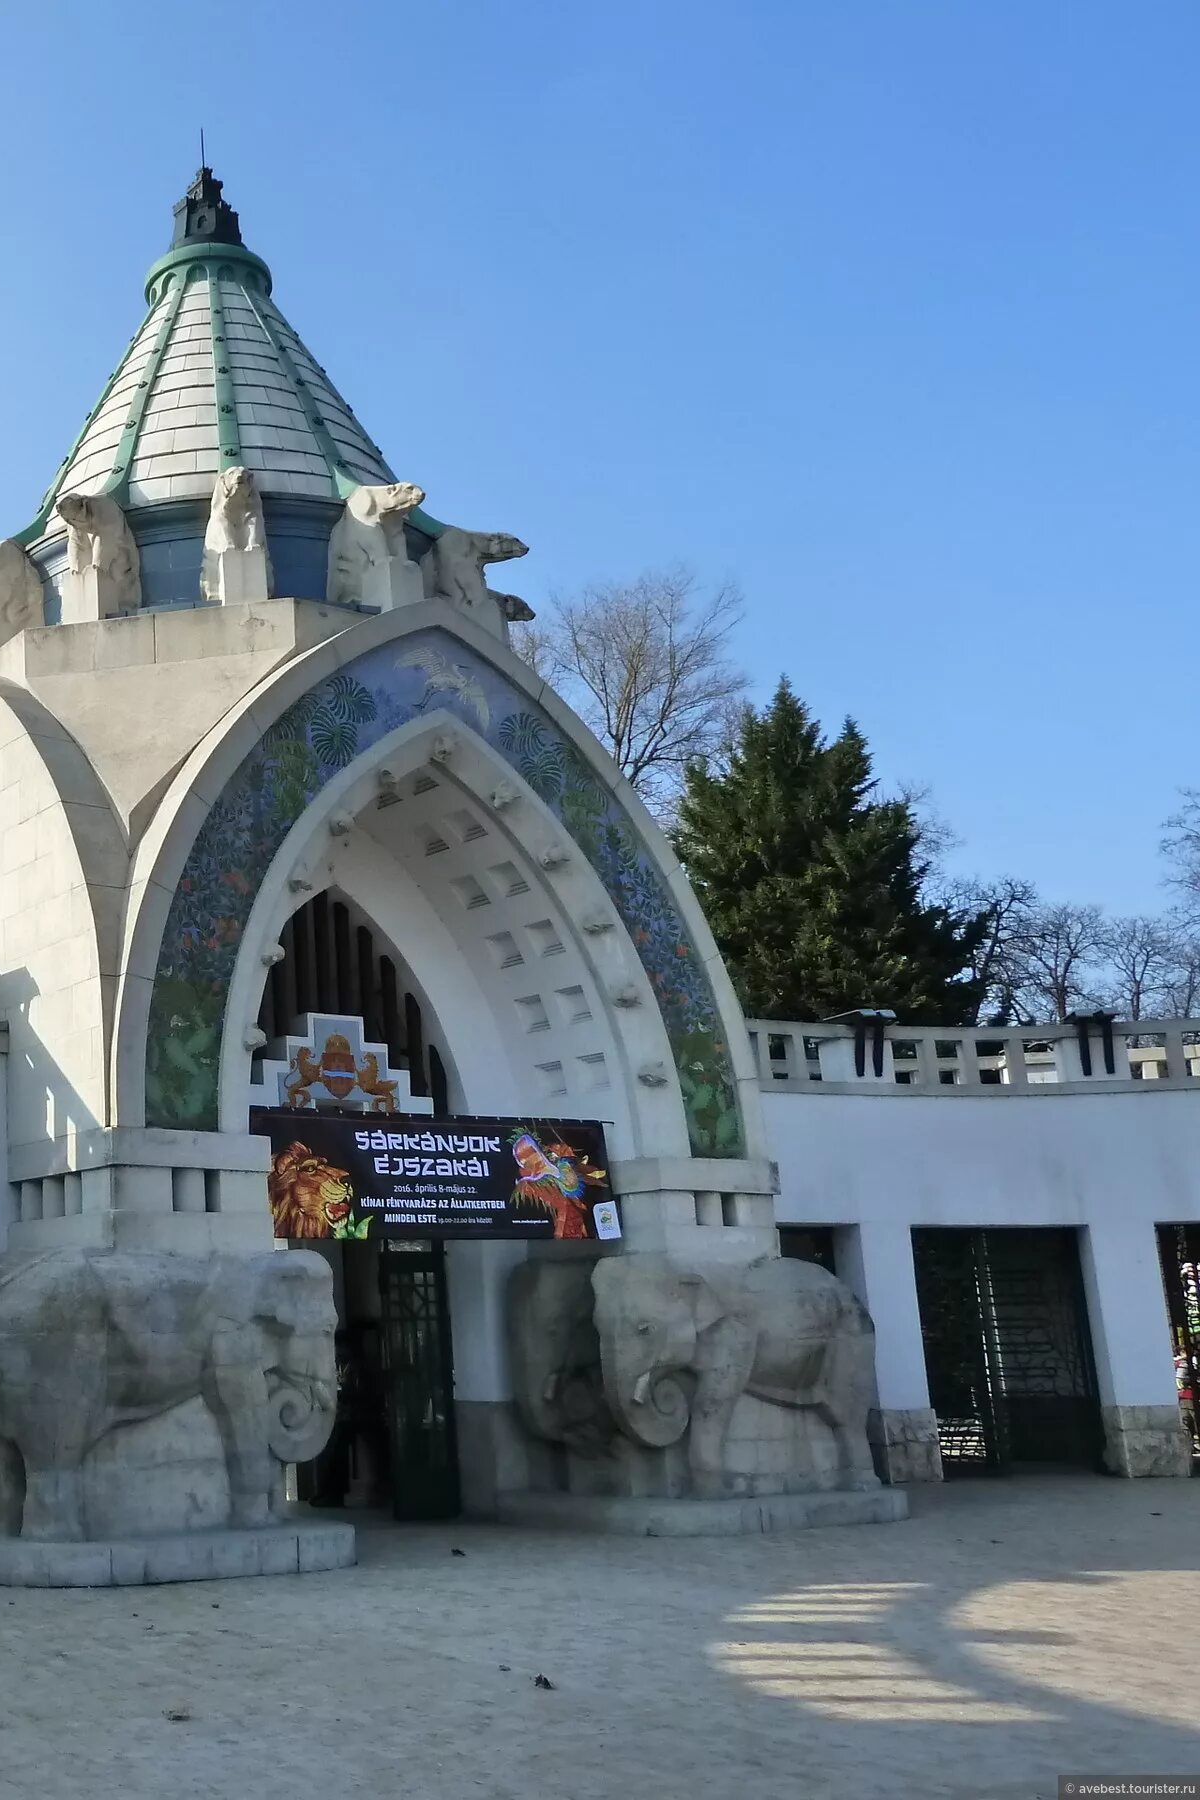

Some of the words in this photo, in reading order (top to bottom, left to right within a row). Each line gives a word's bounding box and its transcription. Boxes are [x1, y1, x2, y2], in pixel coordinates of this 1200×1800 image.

[355, 1129, 501, 1154] SÁRKÁNYOK
[373, 1153, 490, 1177] ÉJSZAKÁI
[393, 1185, 413, 1193] 2016.
[414, 1183, 437, 1194] április
[360, 1196, 384, 1208] KÍNAI
[386, 1197, 436, 1209] FÉNYVARÁZS
[438, 1199, 449, 1208] AZ
[450, 1197, 506, 1210] ÁLLATKERTBEN
[384, 1213, 416, 1223] MINDEN
[417, 1214, 437, 1223] ESTE
